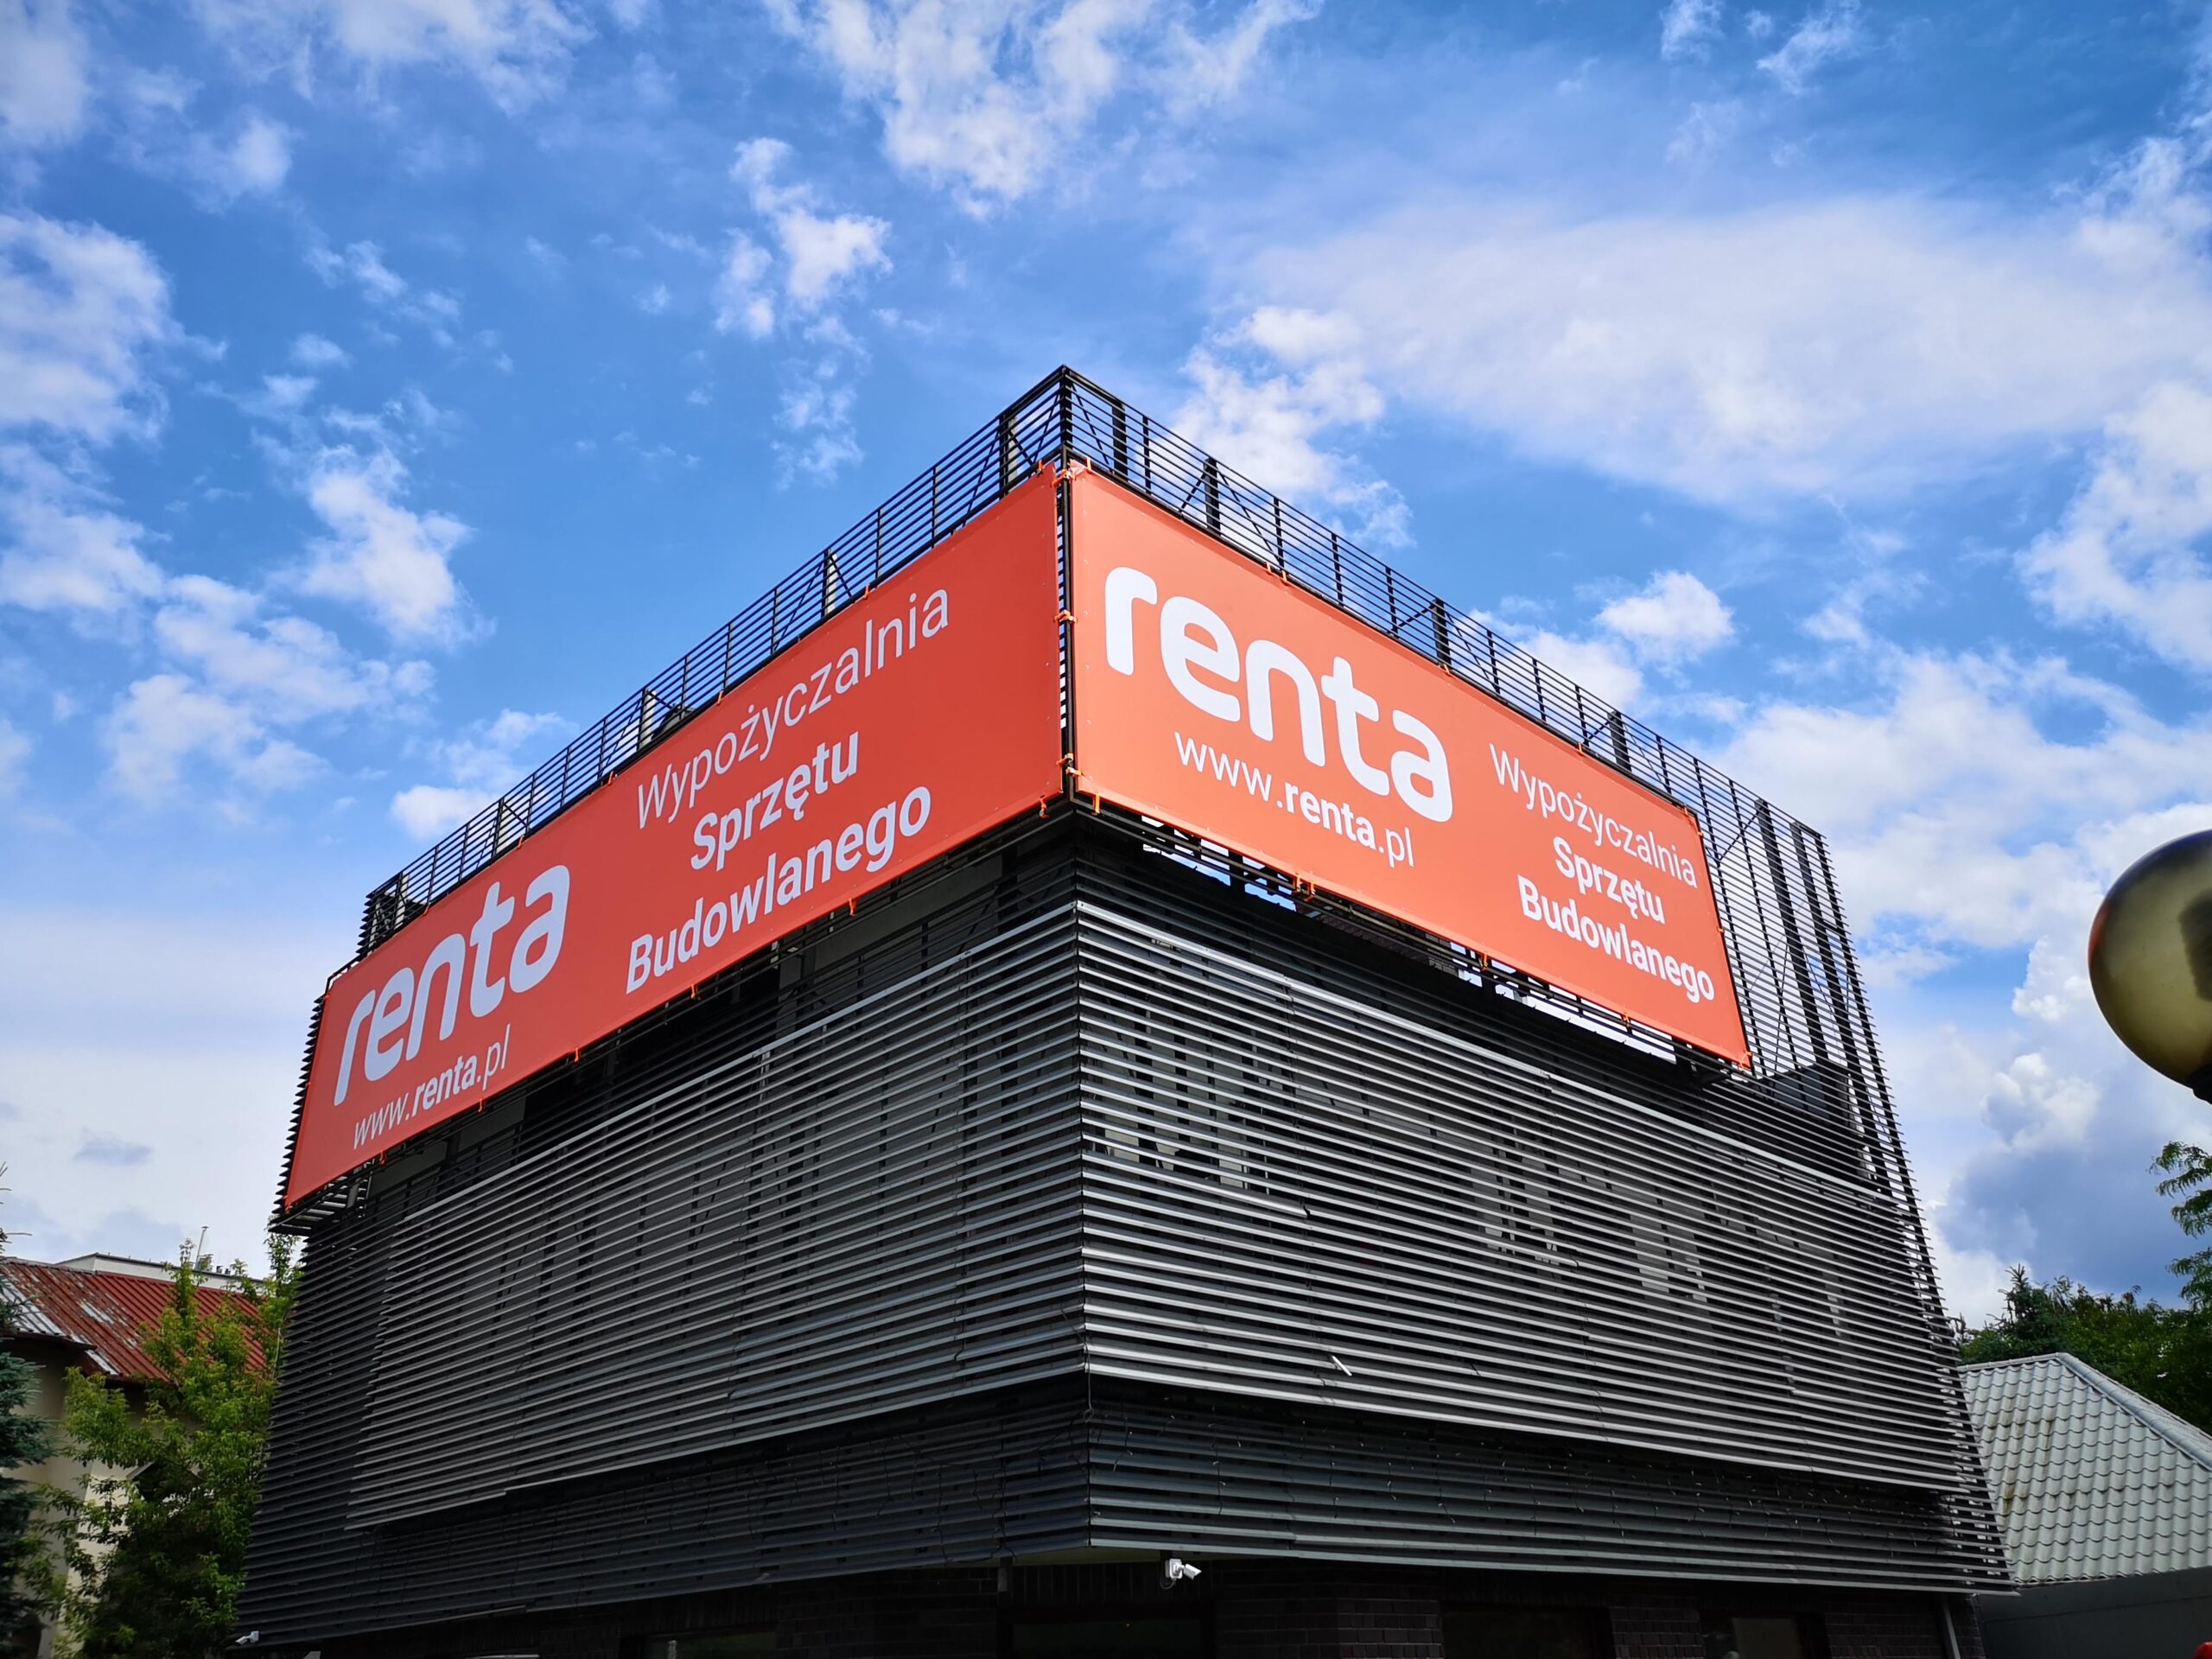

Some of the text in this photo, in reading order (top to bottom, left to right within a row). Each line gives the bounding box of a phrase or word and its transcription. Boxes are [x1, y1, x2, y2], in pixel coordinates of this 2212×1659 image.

[638, 589, 949, 829] Wypożyczalnia
[1103, 567, 1452, 822] renta
[690, 732, 859, 872] Sprzętu
[1174, 732, 1414, 868] www.renta.pl
[1490, 743, 1698, 888] Wypożyczalnia
[626, 787, 931, 995] Budowlanego
[1518, 875, 1714, 1004] Budowlanego
[1554, 837, 1665, 924] Sprzętu
[334, 865, 570, 1107] renta
[353, 1023, 511, 1150] www.renta.pl
